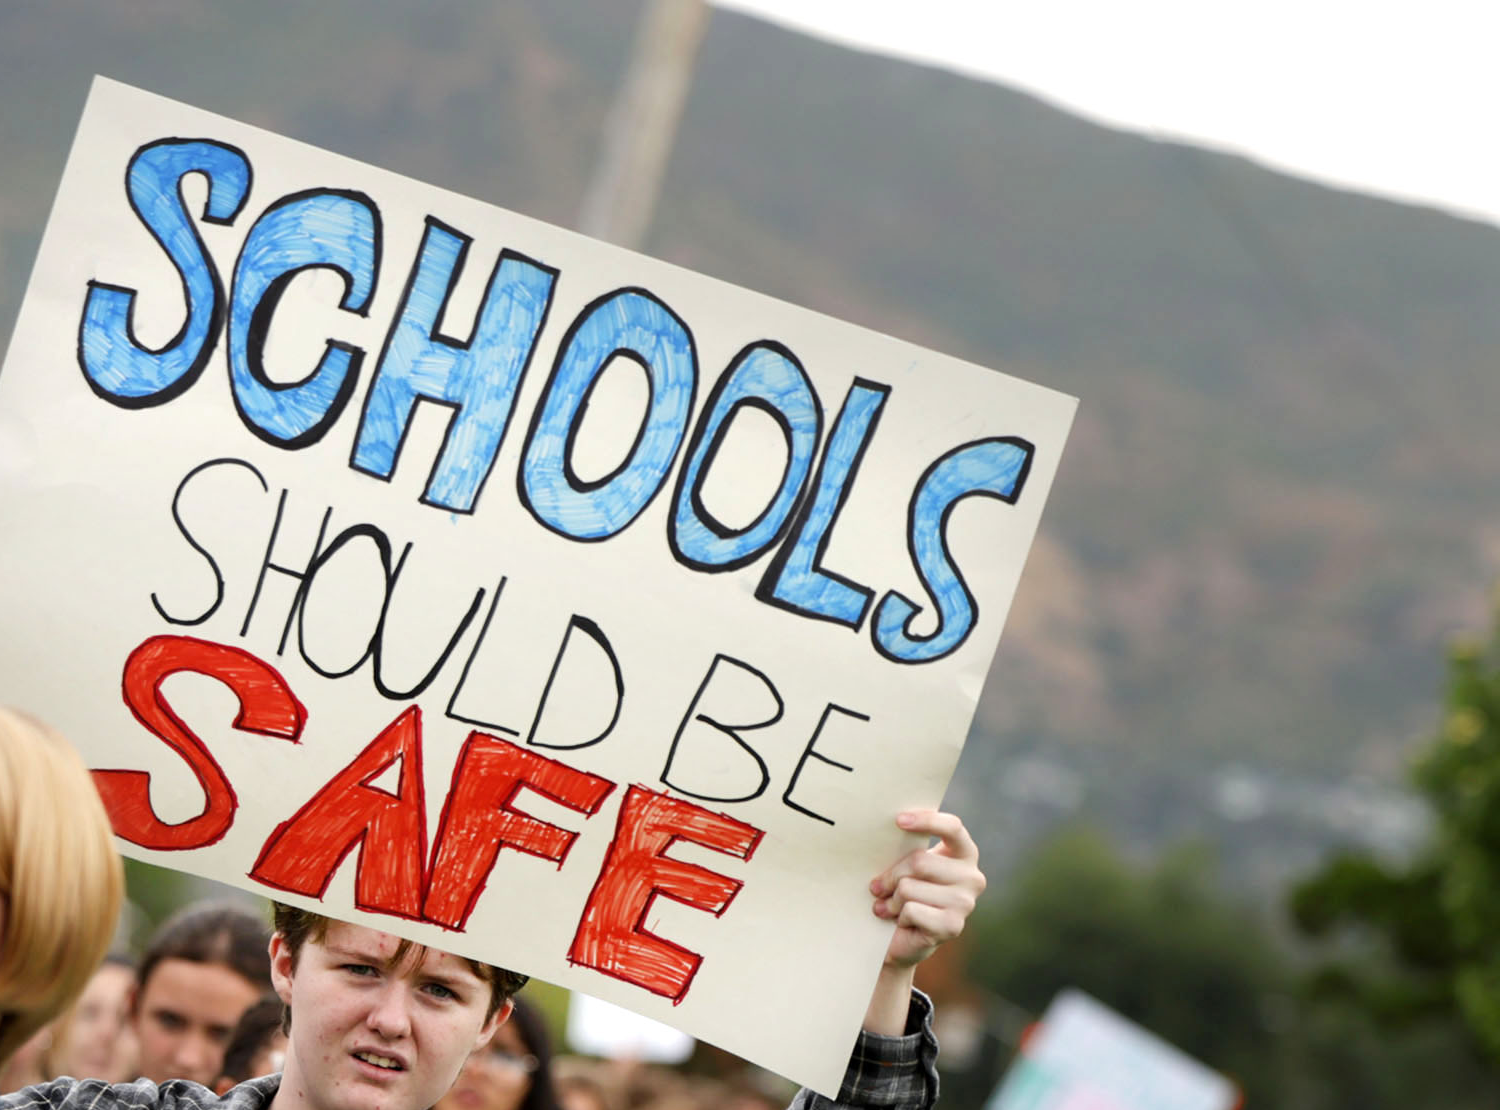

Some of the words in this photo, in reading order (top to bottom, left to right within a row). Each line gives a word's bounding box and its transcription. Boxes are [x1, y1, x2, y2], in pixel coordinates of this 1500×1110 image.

[78, 137, 1035, 665] SCHOOLS
[90, 635, 767, 1006] SAFE
[151, 458, 625, 750] SHOULD
[659, 652, 870, 826] BE
